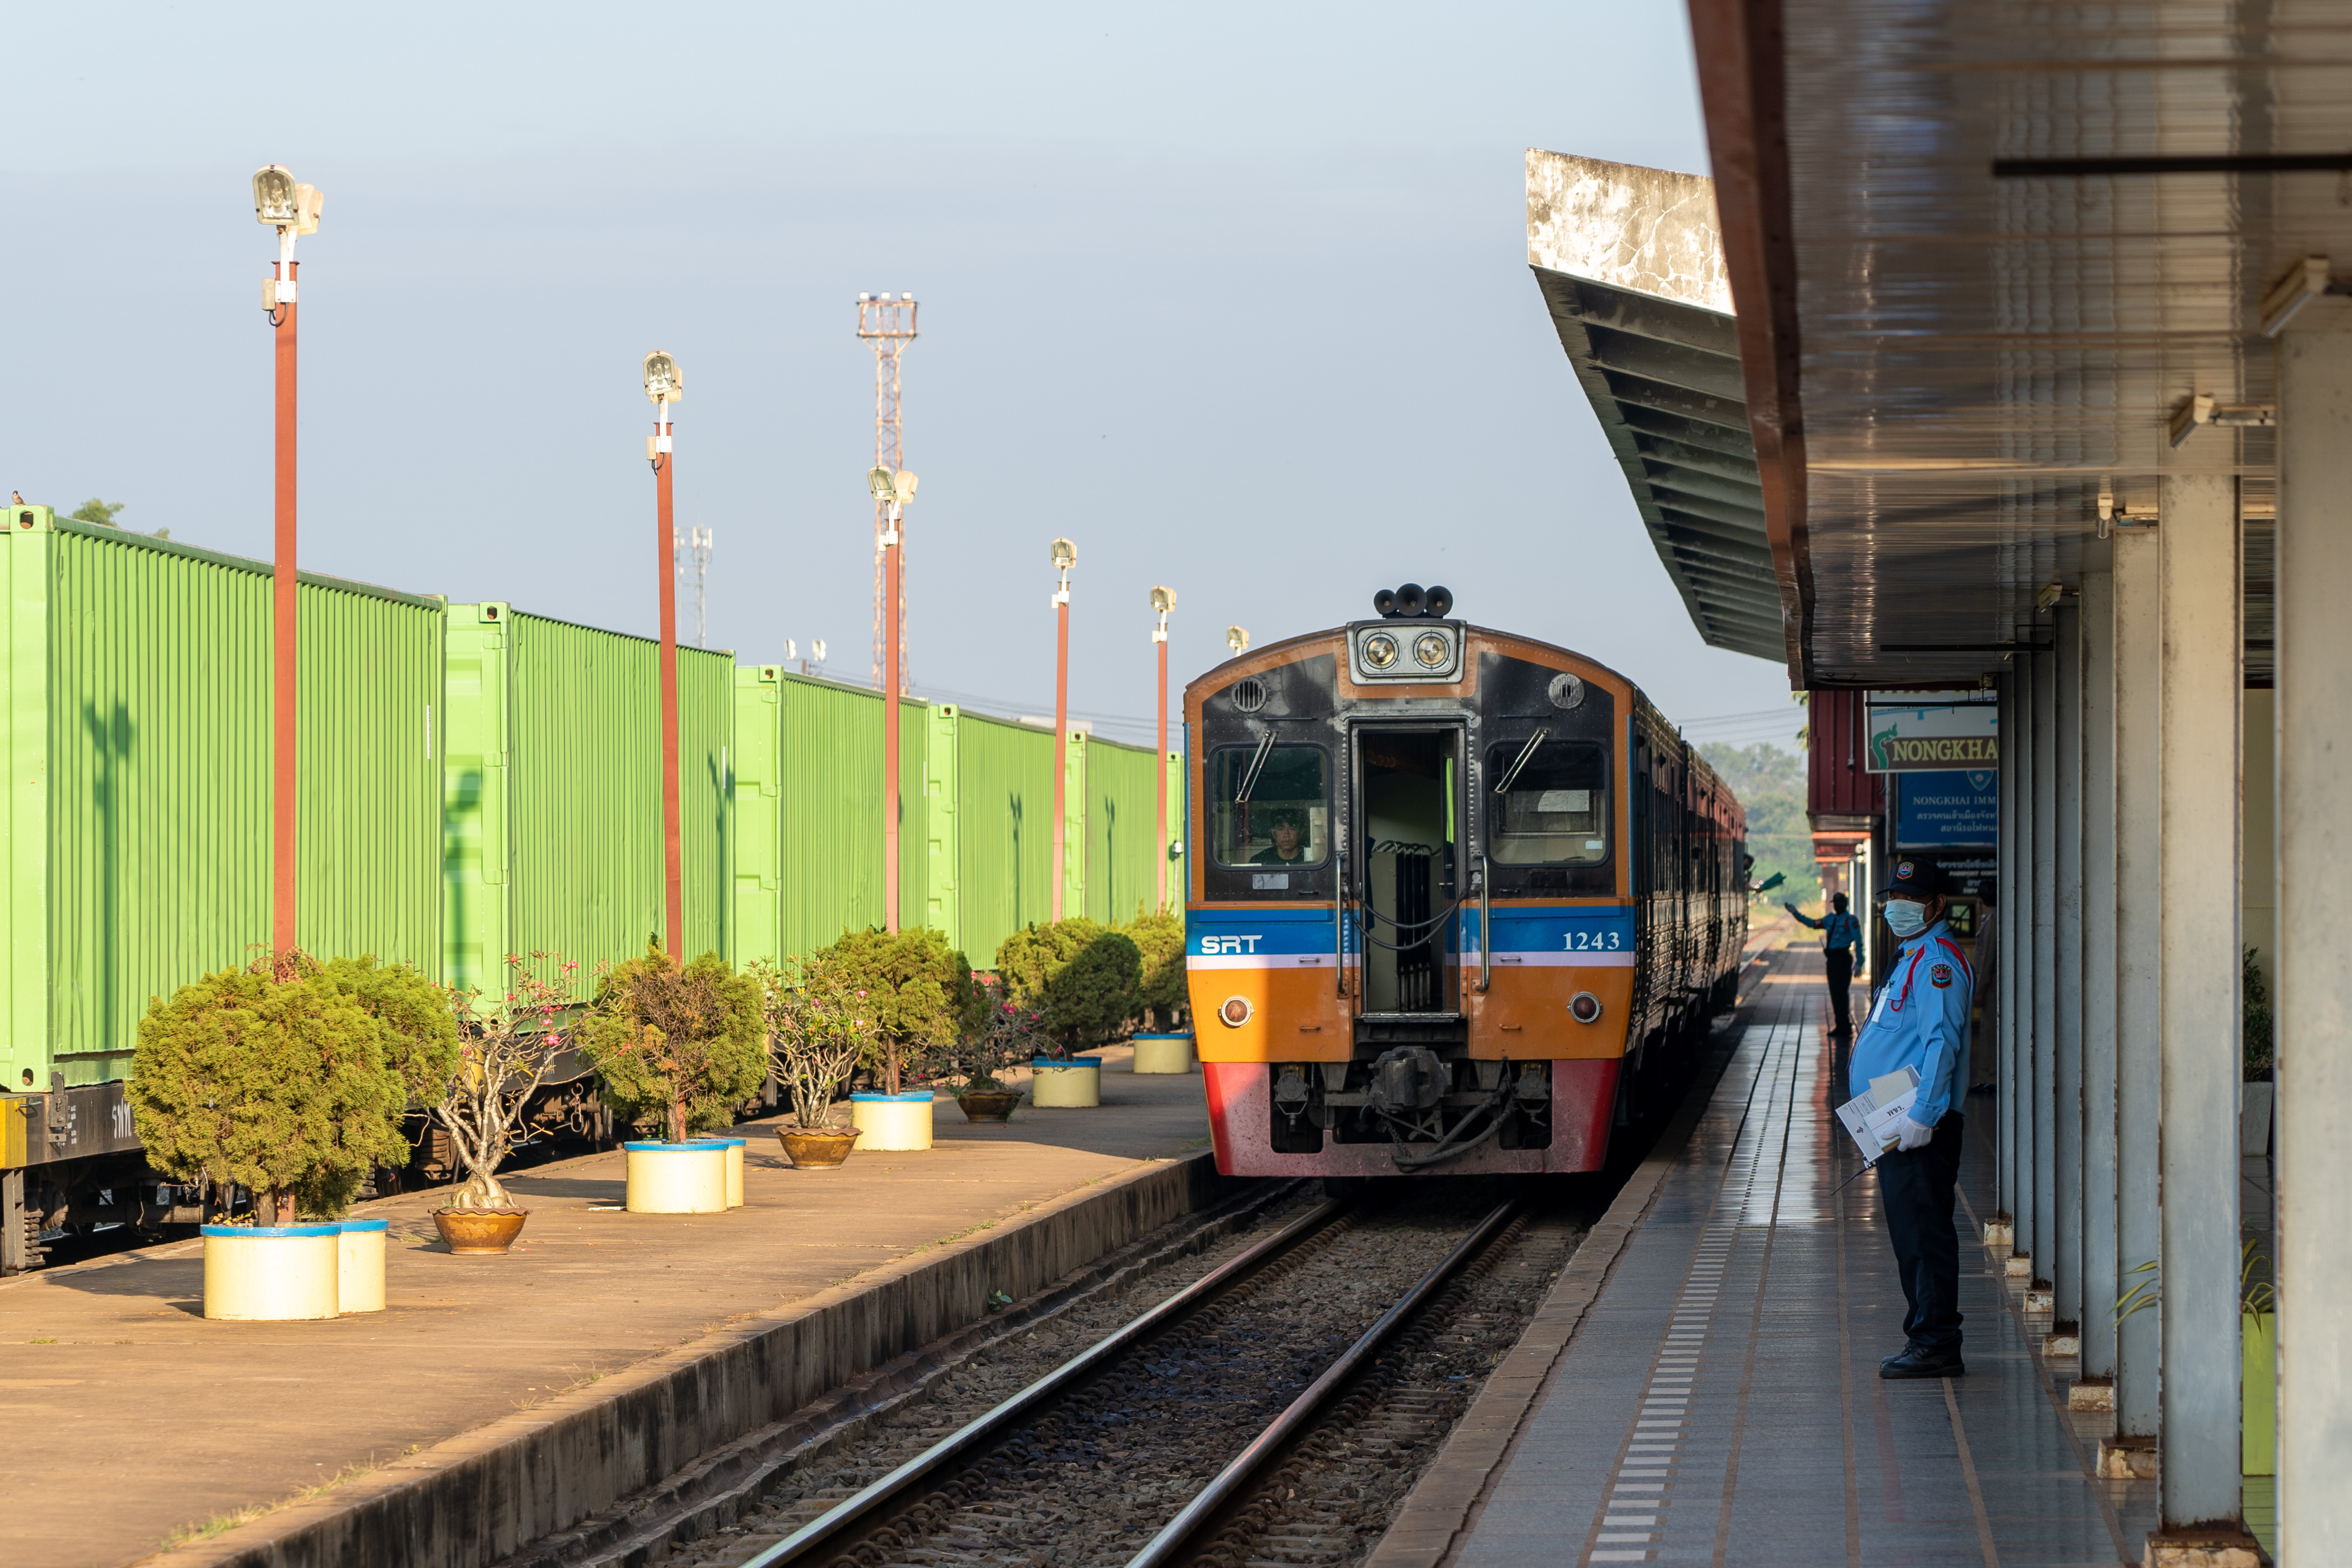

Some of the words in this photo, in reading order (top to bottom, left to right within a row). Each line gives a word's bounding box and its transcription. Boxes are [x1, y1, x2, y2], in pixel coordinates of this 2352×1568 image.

[1892, 738, 1997, 762] NONGKHA
[1913, 796, 1970, 806] NONGKHAI
[1974, 796, 1996, 805] IMM
[1201, 935, 1263, 954] SRT
[1563, 932, 1619, 950] 1243
